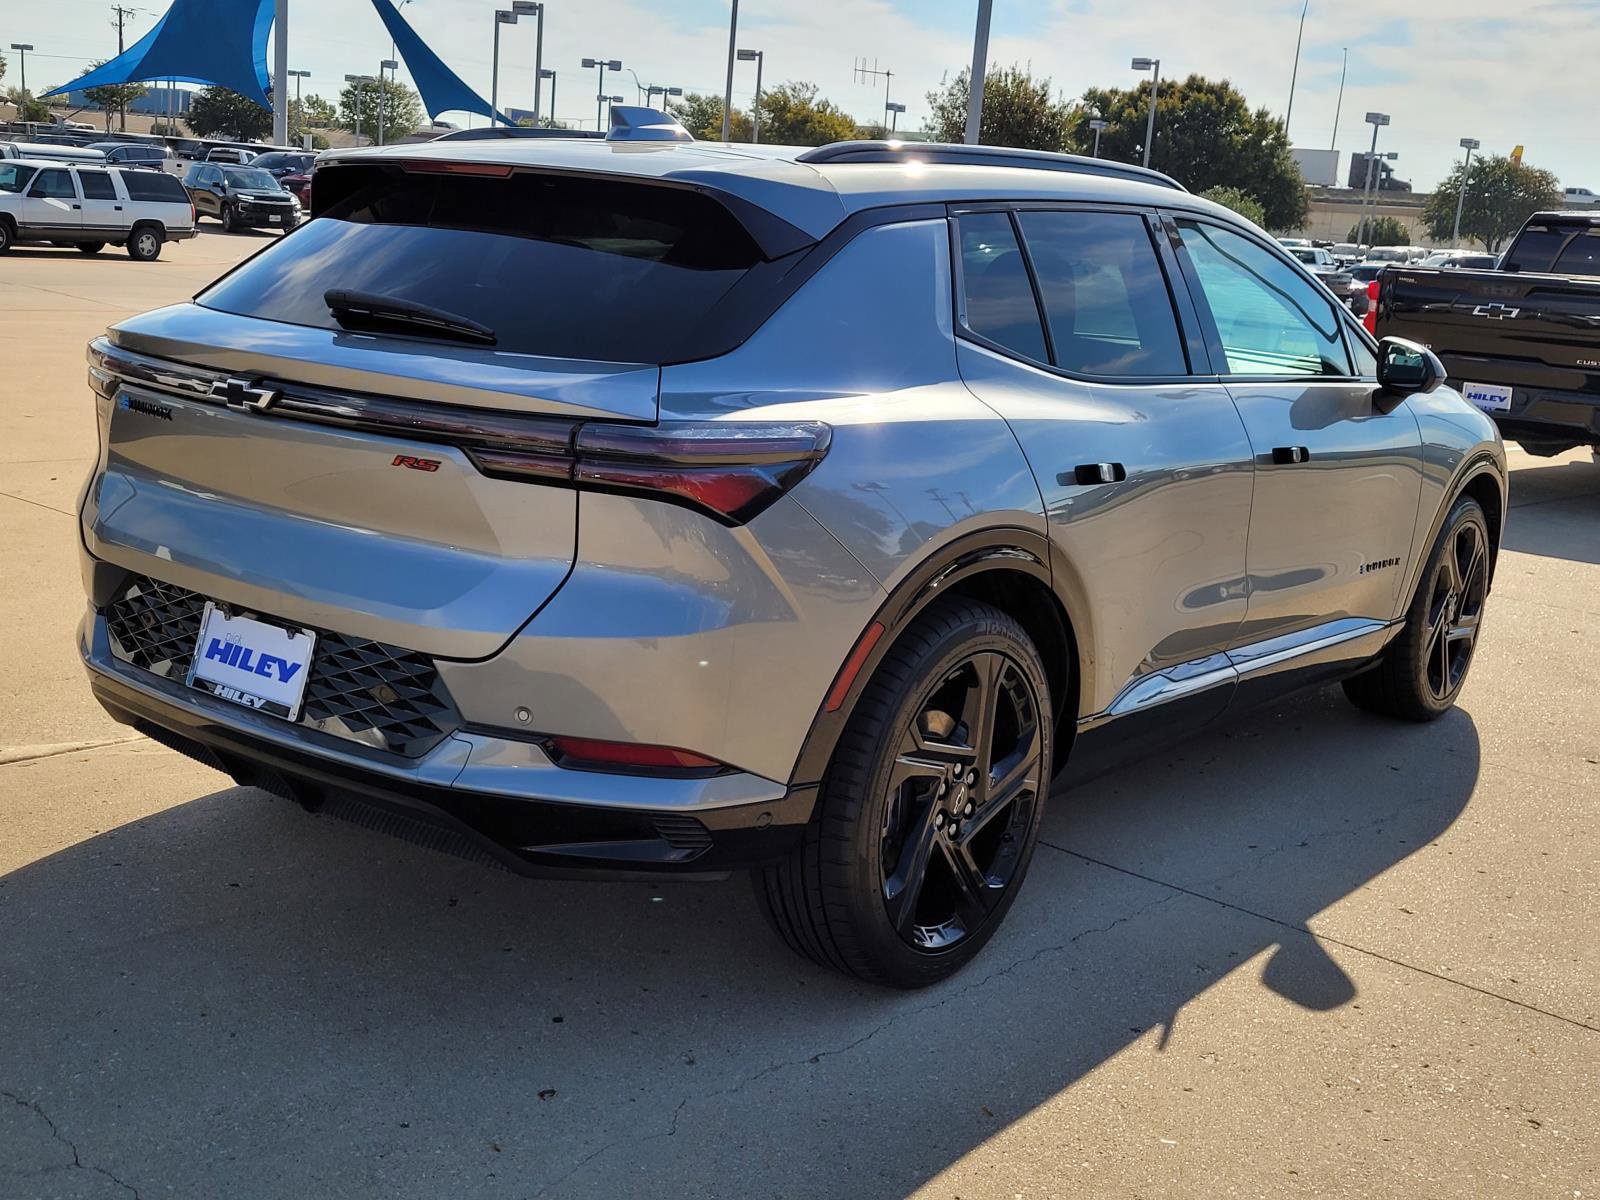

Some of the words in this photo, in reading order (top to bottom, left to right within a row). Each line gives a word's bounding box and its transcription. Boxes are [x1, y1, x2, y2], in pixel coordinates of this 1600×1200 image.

[1466, 392, 1508, 402] HILEY
[391, 455, 441, 472] RS
[205, 638, 302, 683] HILEY
[213, 684, 266, 709] HILEY
